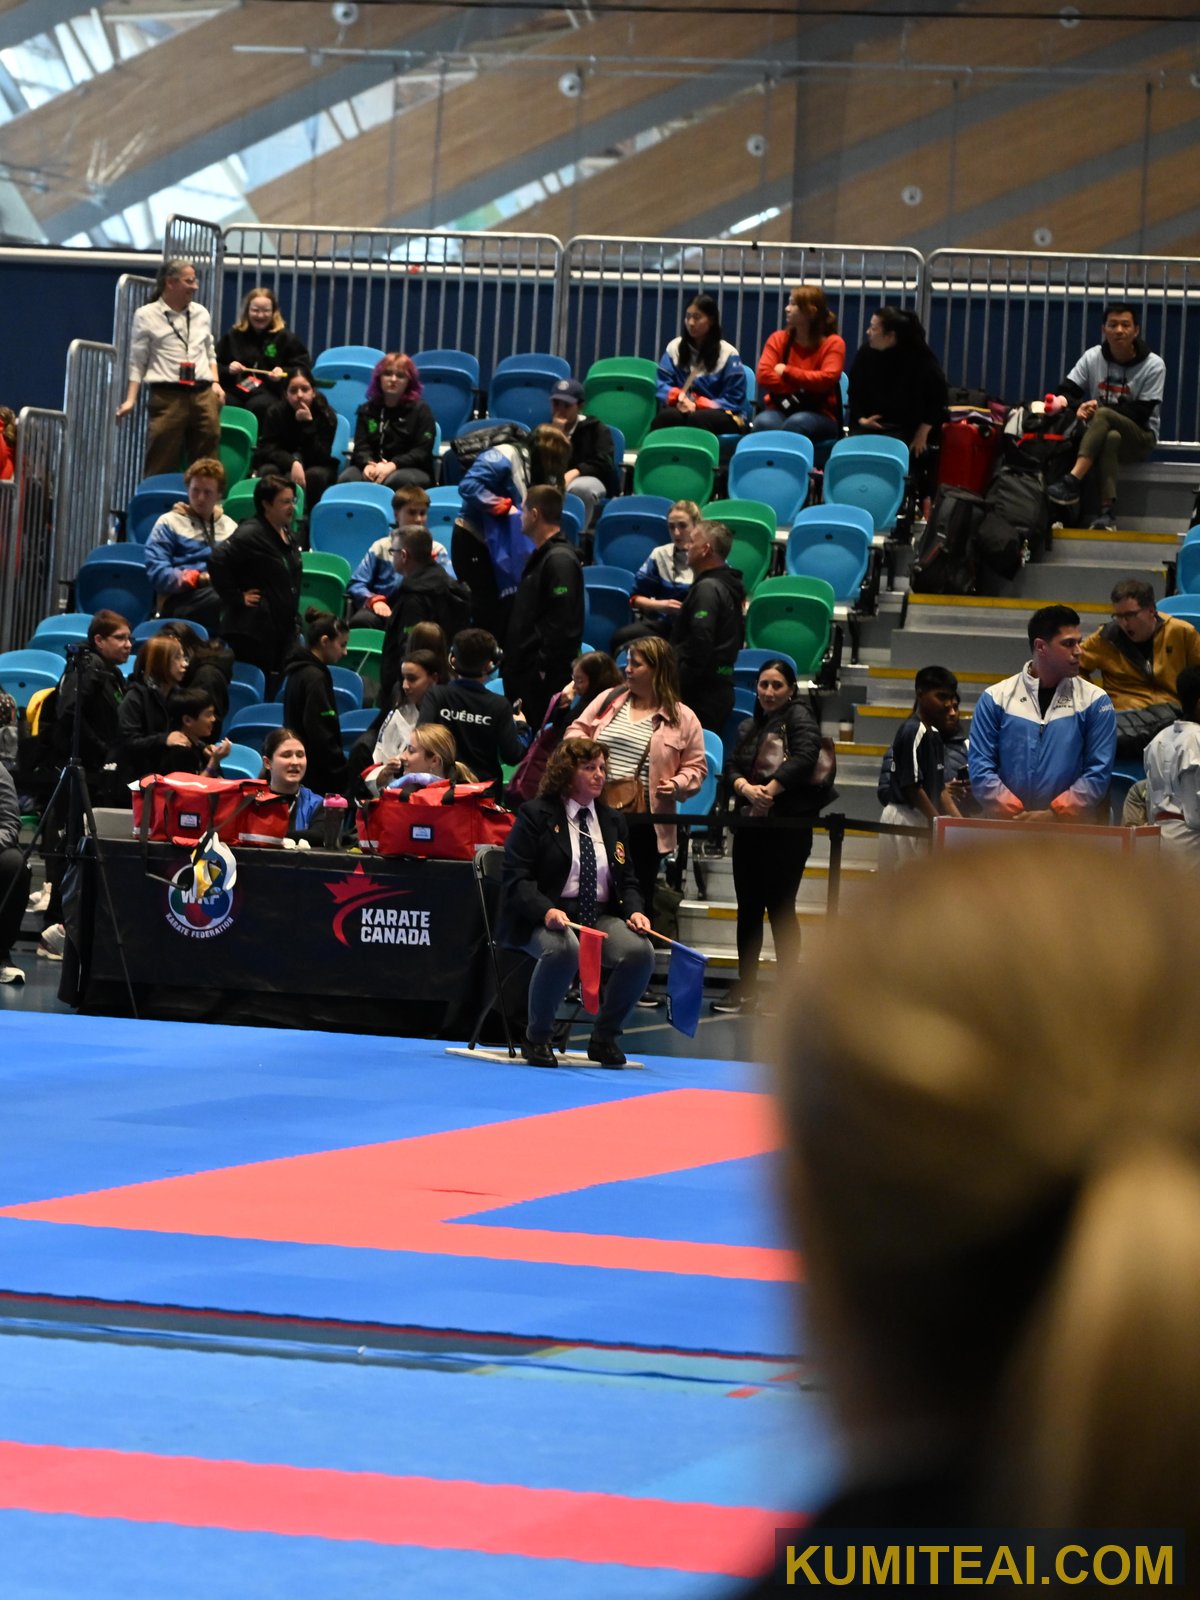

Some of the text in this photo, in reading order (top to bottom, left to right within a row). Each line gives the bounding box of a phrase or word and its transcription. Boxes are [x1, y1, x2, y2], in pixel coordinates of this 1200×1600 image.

[440, 708, 492, 725] QUÉBEC
[165, 912, 234, 938] KARATE FEDERATION
[361, 908, 431, 928] KARATE
[360, 926, 431, 946] CANADA
